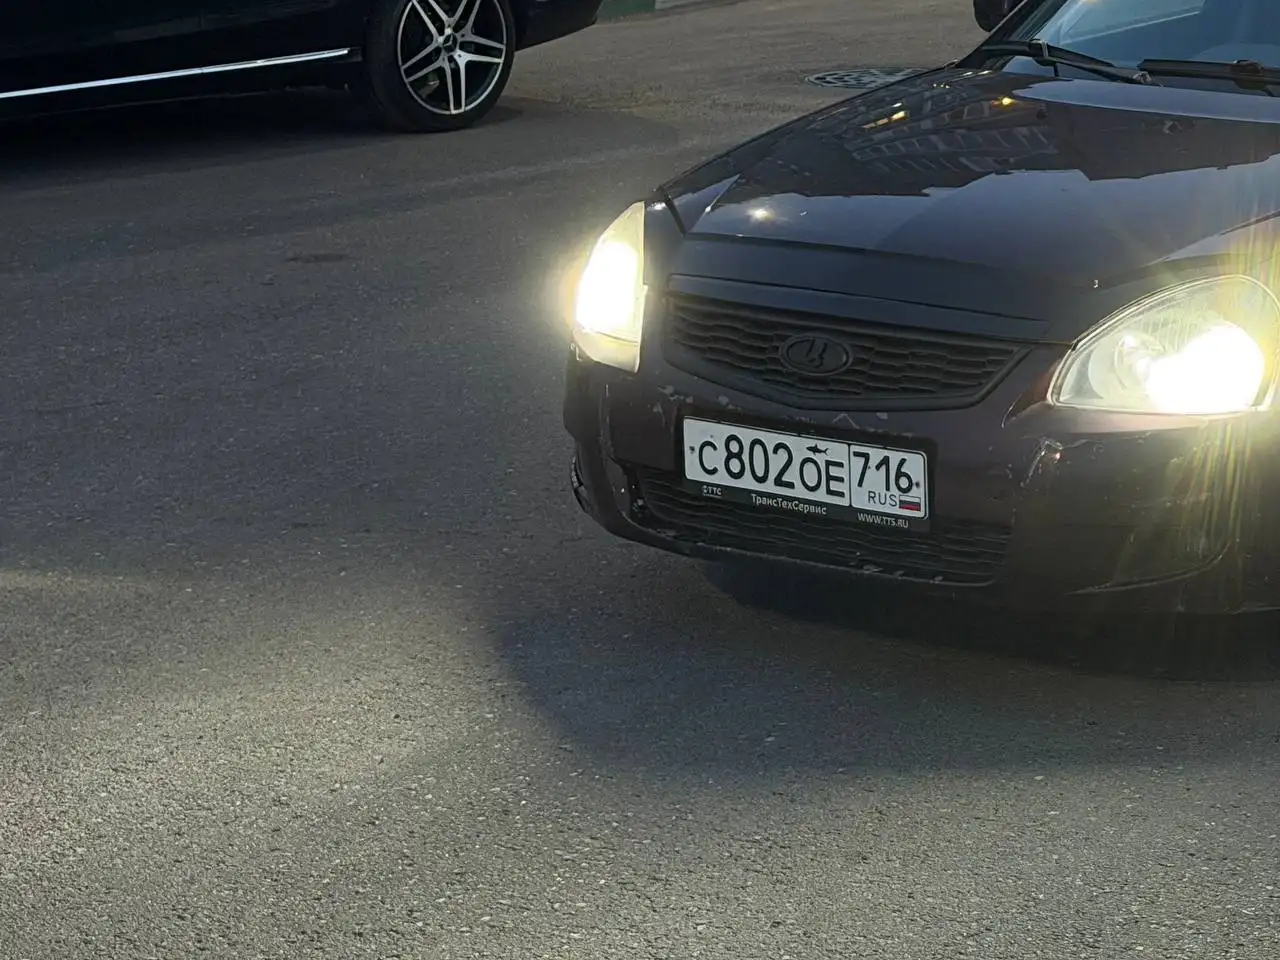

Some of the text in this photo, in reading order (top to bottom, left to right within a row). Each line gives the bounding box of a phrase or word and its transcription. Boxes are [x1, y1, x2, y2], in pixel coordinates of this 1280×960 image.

[852, 451, 913, 494] 716
[750, 493, 827, 515] ТрансТехСервис
[867, 490, 898, 507] RUS
